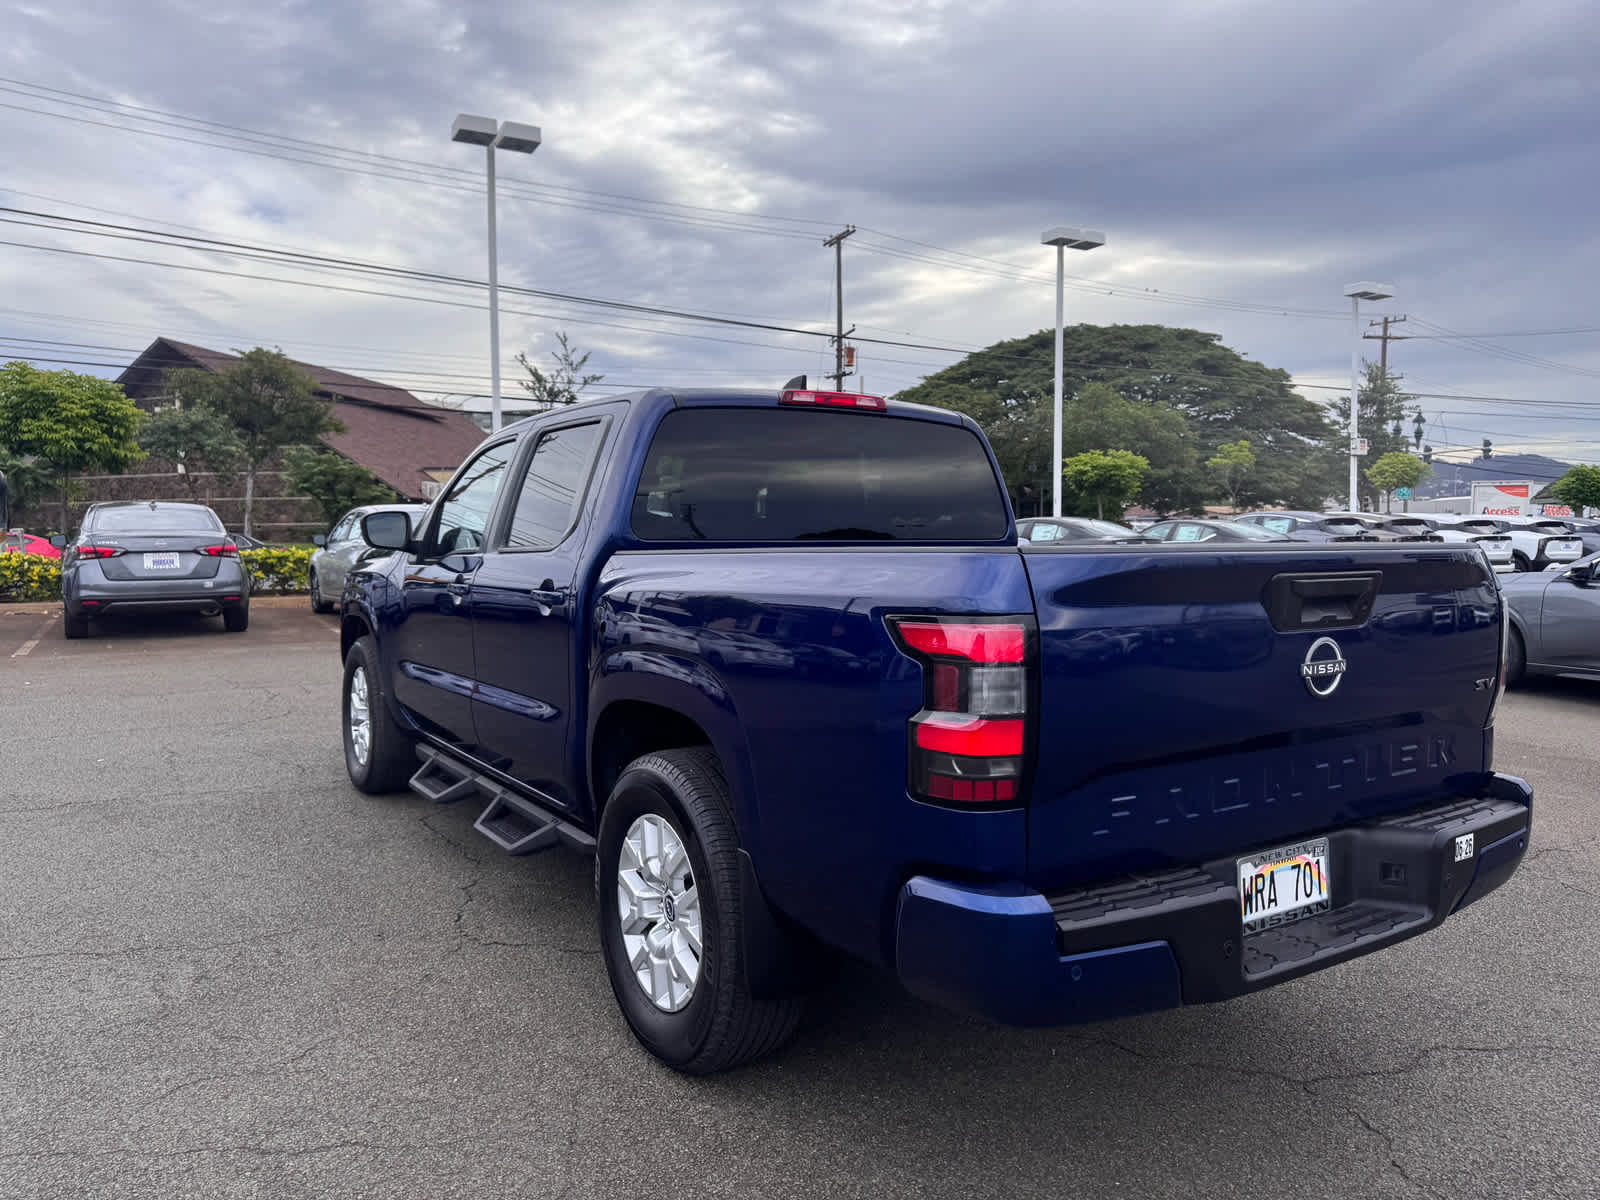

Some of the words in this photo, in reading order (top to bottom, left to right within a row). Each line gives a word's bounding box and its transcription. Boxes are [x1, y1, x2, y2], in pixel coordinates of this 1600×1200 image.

[1482, 505, 1520, 516] Access
[1303, 662, 1347, 675] NISSAN
[1472, 676, 1495, 691] SV
[1242, 870, 1278, 917] WRA
[1291, 858, 1322, 902] 701
[1243, 900, 1329, 936] NISSAN
